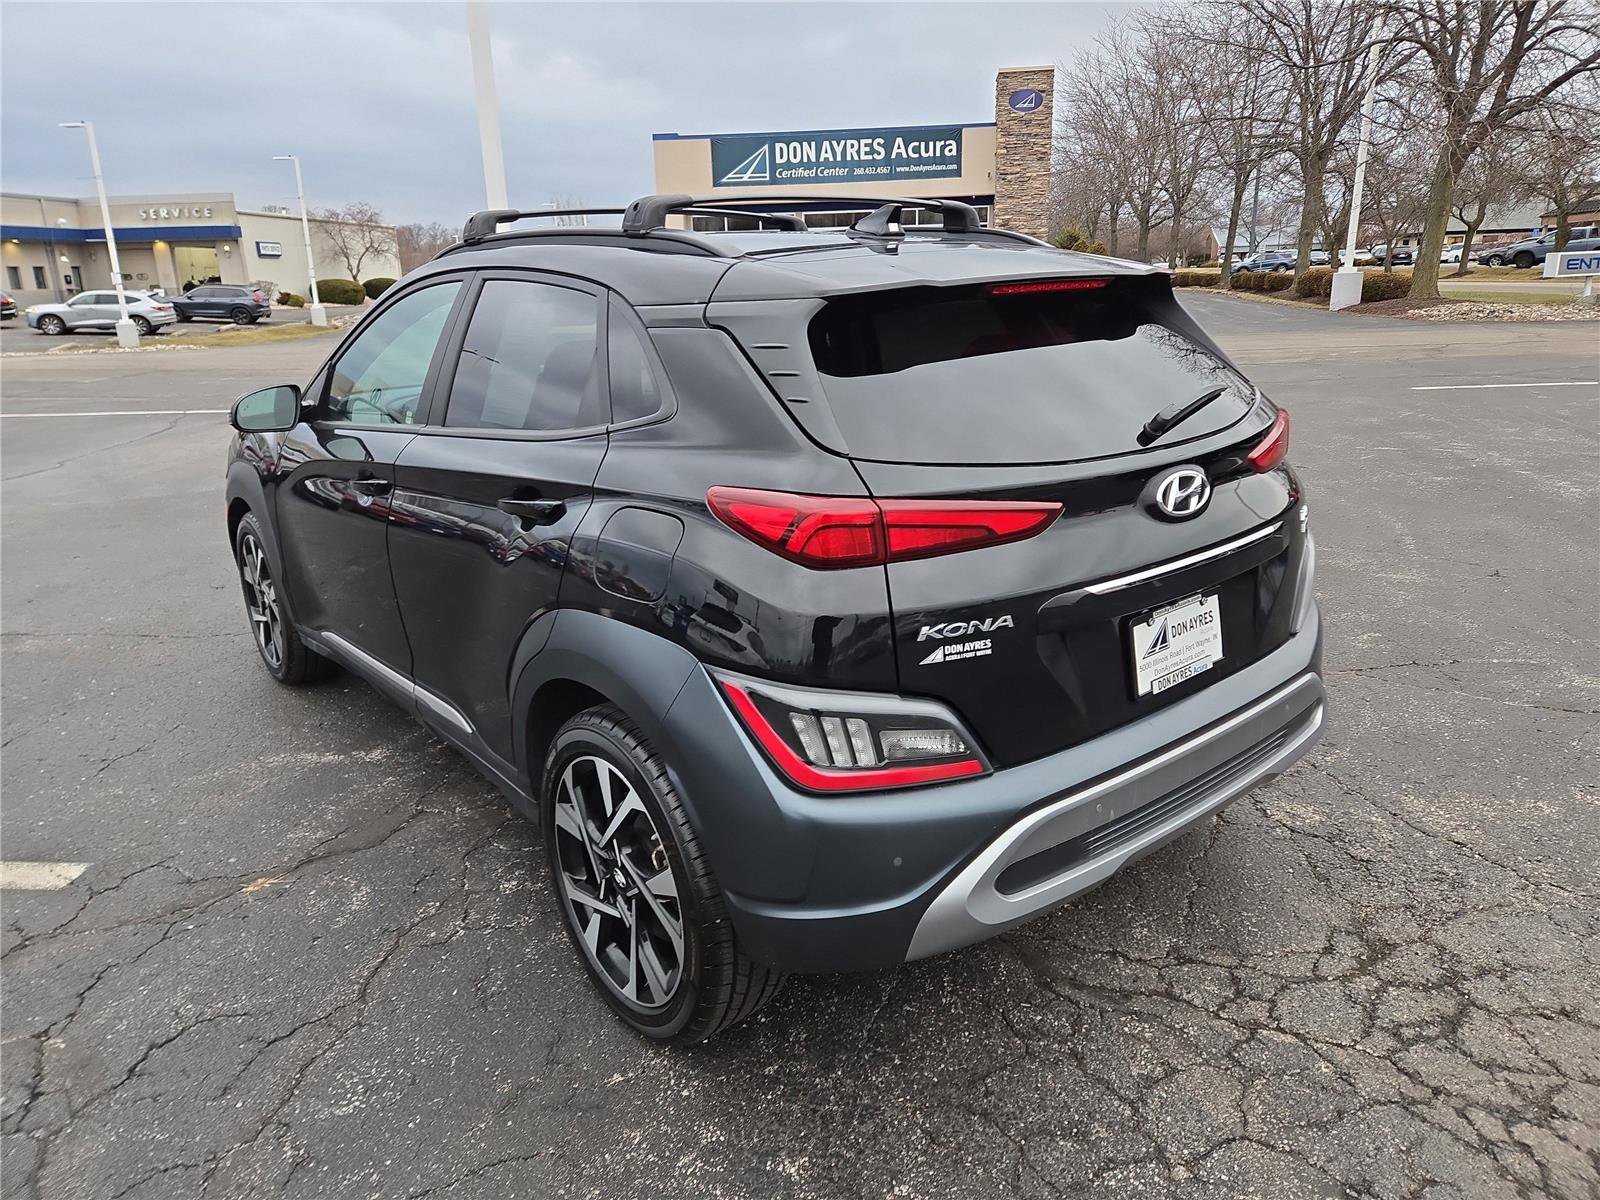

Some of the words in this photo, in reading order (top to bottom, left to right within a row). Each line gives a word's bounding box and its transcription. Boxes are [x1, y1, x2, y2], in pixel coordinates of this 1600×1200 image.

[775, 141, 816, 164] DON
[819, 138, 885, 162] AYRES
[891, 137, 957, 159] Acura
[776, 166, 816, 178] Certified
[818, 167, 849, 177] Center
[896, 163, 957, 172] www.DonAyresAcura.com
[138, 207, 213, 220] SERVICE
[917, 615, 1014, 641] KONA
[1171, 621, 1188, 638] DON
[1189, 610, 1214, 632] AYRES
[945, 644, 963, 655] DON
[964, 639, 992, 652] AYRES
[1157, 675, 1171, 690] DON
[1172, 666, 1192, 684] AYRES
[1193, 663, 1208, 673] Acura
